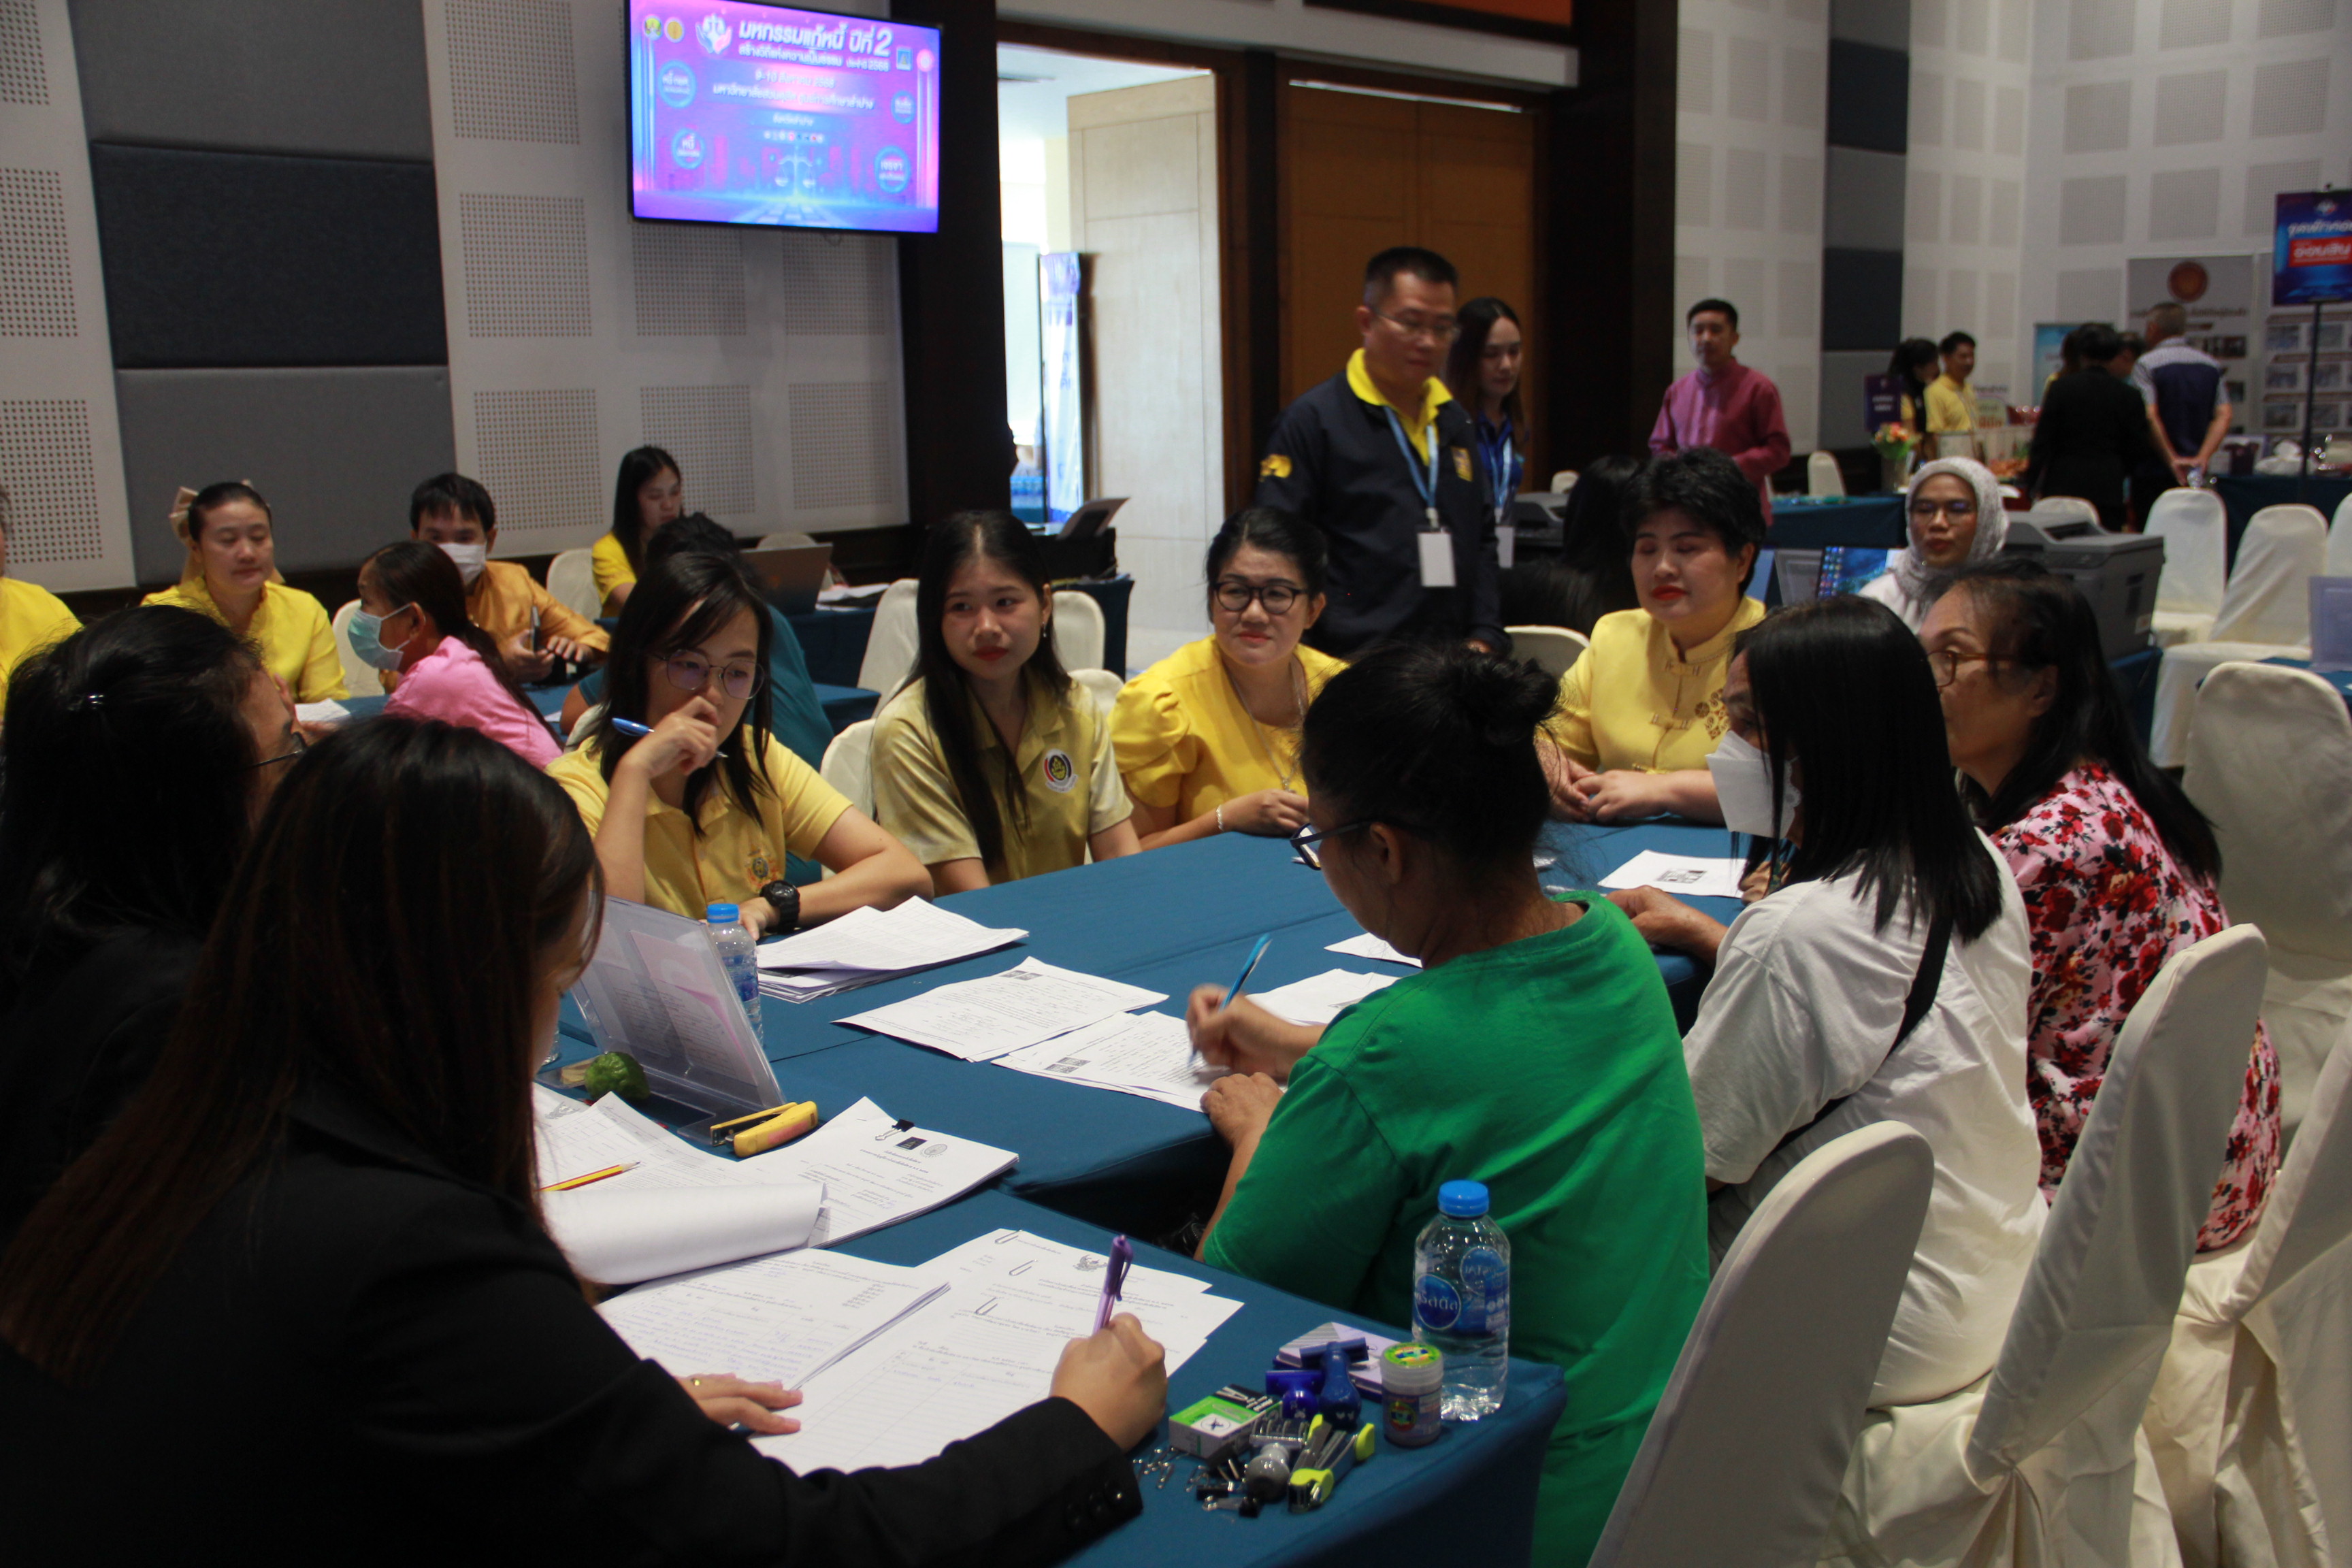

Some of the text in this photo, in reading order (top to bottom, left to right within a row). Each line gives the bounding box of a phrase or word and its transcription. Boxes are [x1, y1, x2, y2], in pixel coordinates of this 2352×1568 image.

[739, 20, 894, 58] มหกรรมแก้หนี้ ปีที่ 2
